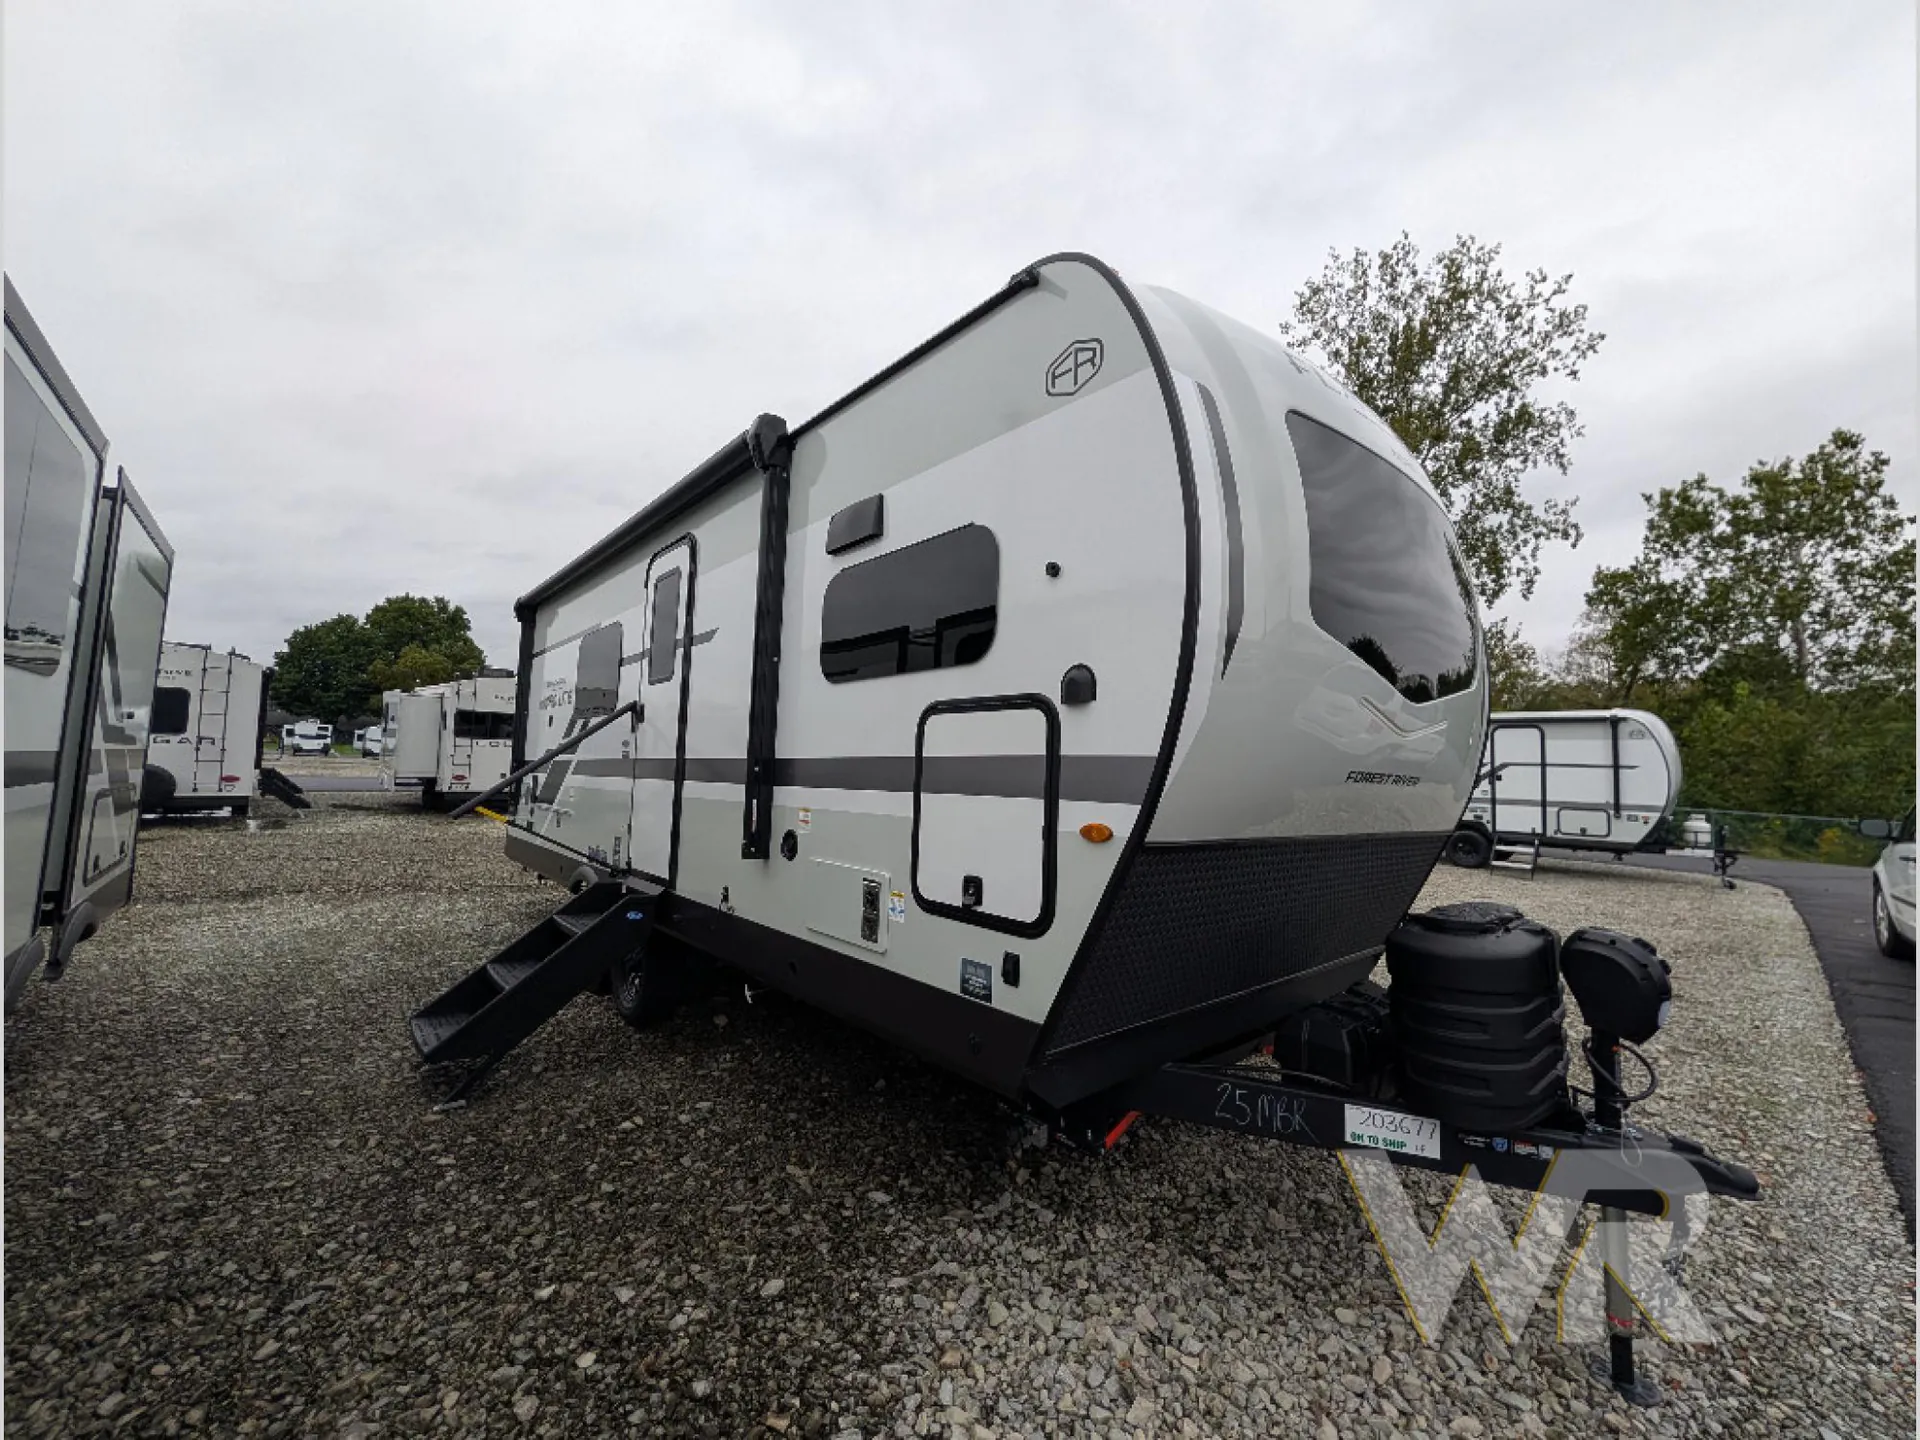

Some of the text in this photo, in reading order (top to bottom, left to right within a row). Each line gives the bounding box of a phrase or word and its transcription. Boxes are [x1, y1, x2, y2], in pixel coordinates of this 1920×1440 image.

[1344, 770, 1393, 785] FOREST
[1359, 1110, 1437, 1140] 203677
[1367, 1135, 1379, 1146] TO
[1382, 1137, 1407, 1150] SHIP
